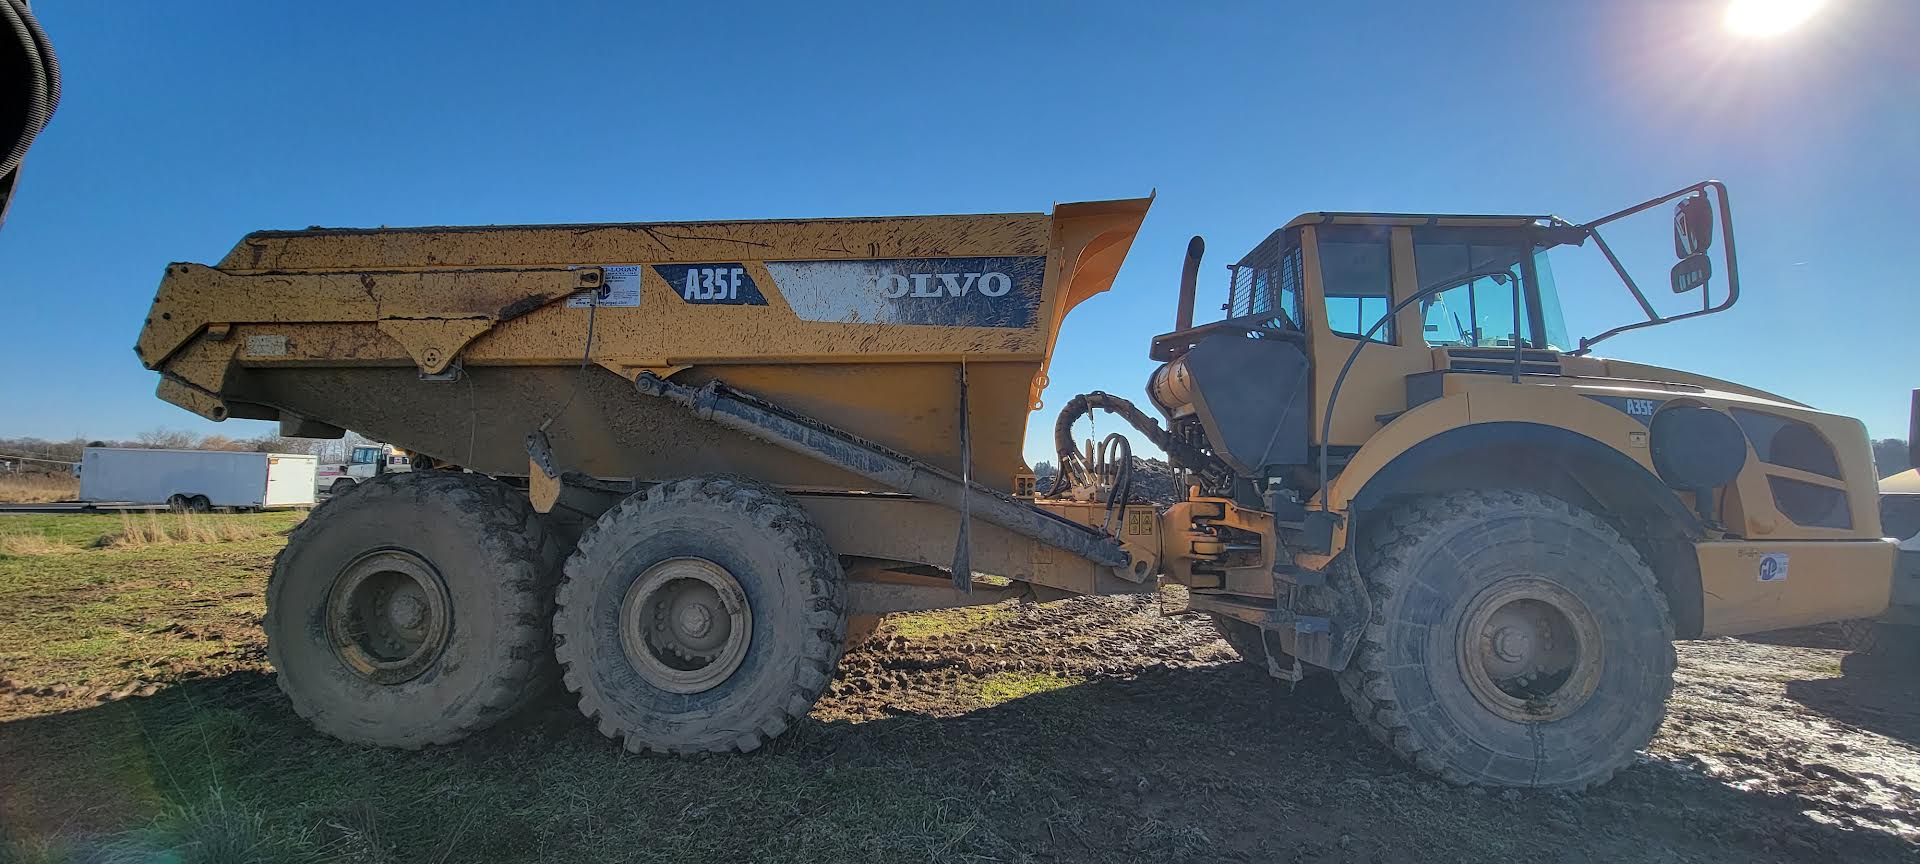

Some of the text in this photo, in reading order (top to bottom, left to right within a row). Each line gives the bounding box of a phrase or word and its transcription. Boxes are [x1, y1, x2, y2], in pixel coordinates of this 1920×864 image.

[684, 268, 744, 300] A35F
[876, 272, 1012, 299] OLVO
[1626, 398, 1654, 416] A35F
